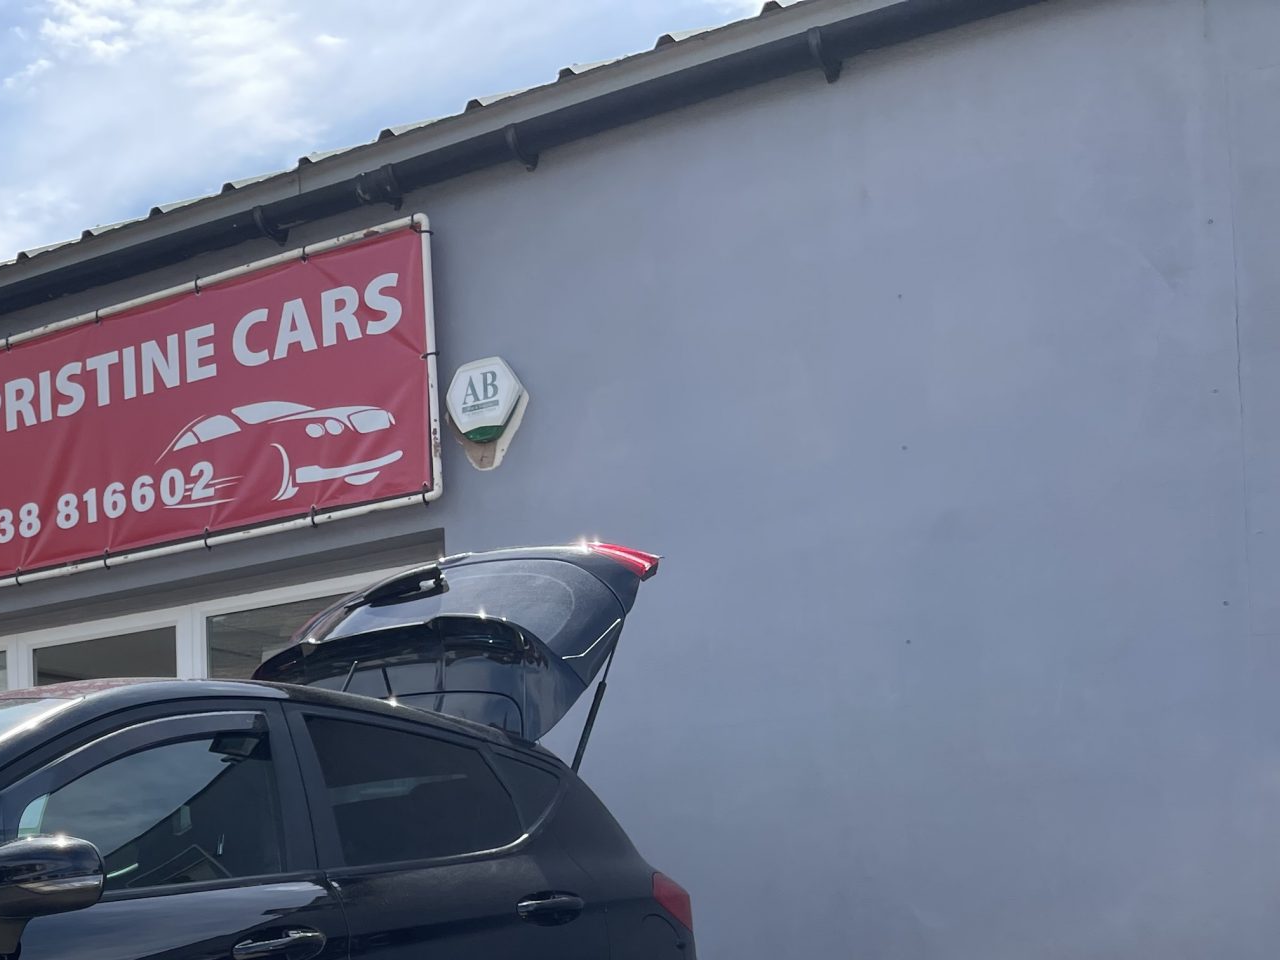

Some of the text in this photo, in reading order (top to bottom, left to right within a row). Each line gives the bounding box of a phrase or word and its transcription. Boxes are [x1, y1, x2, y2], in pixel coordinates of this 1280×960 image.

[231, 272, 403, 367] CARS
[462, 370, 499, 405] AB
[55, 461, 216, 530] 816602
